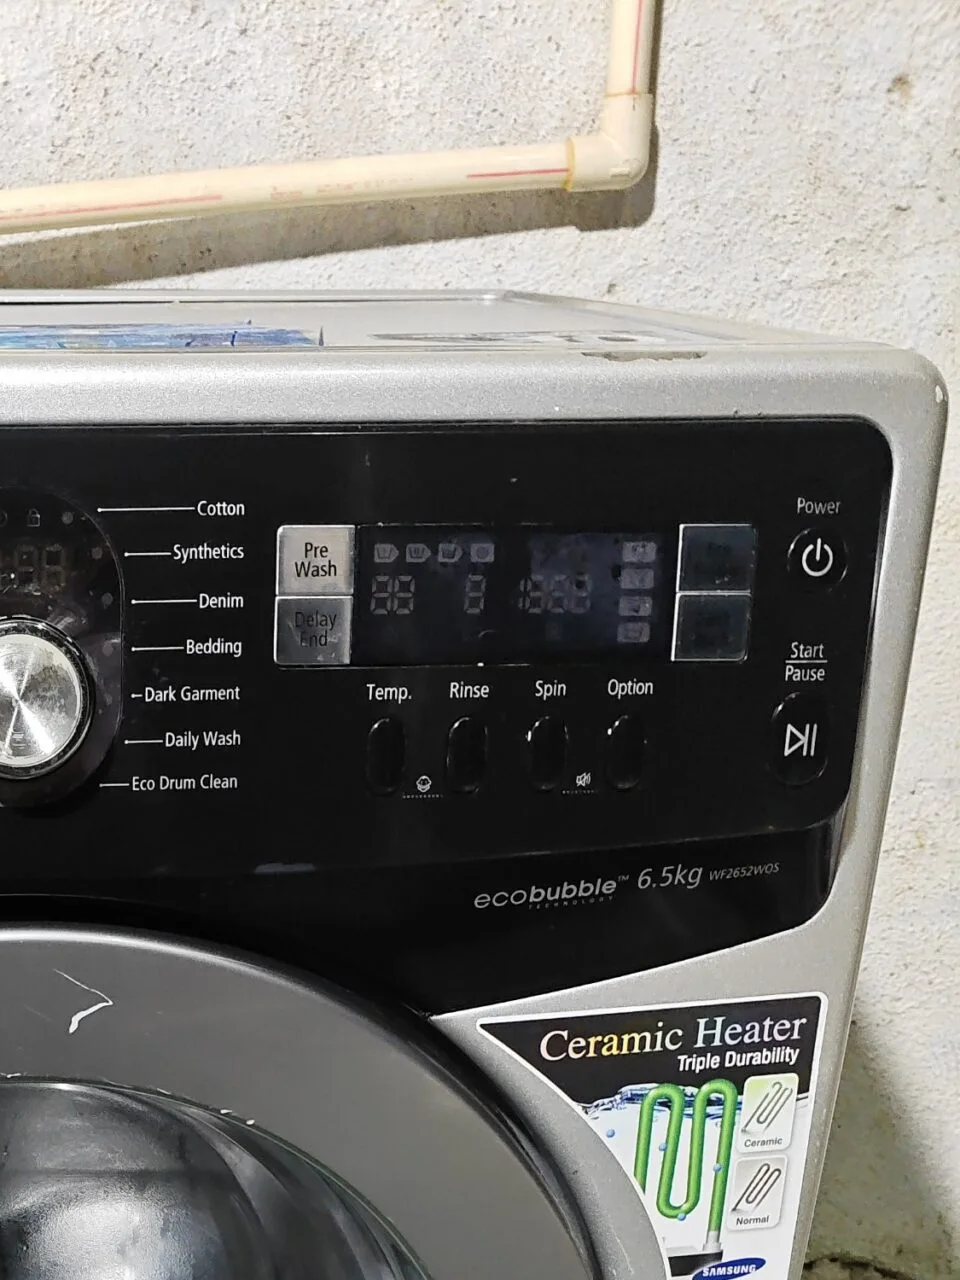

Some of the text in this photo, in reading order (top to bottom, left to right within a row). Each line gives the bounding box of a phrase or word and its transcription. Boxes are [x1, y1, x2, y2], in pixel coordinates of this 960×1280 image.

[197, 500, 245, 516] Cotton
[797, 497, 841, 514] Power
[173, 543, 245, 564] Synthetics
[304, 542, 329, 558] Pre
[295, 560, 337, 577] Wash
[199, 592, 244, 609] Denim
[294, 610, 337, 631] Delay
[186, 638, 242, 657] Bedding
[300, 630, 329, 647] End
[790, 641, 825, 659] Start
[784, 664, 826, 682] Pause
[145, 685, 241, 702] Dark Garment
[366, 683, 412, 704] Temp.
[449, 681, 490, 699] Rinse
[534, 679, 567, 701] Spin
[607, 678, 654, 700] Option
[165, 729, 241, 751] Daily Wash
[132, 773, 238, 791] Eco Drum Clean
[637, 863, 704, 890] 6.5kg
[540, 1015, 808, 1061] Ceramic Heater
[676, 1047, 801, 1073] Triple Durability
[743, 1136, 783, 1149] Ceramic
[735, 1215, 770, 1227] Normal
[702, 1264, 757, 1277] SAMSUNG
